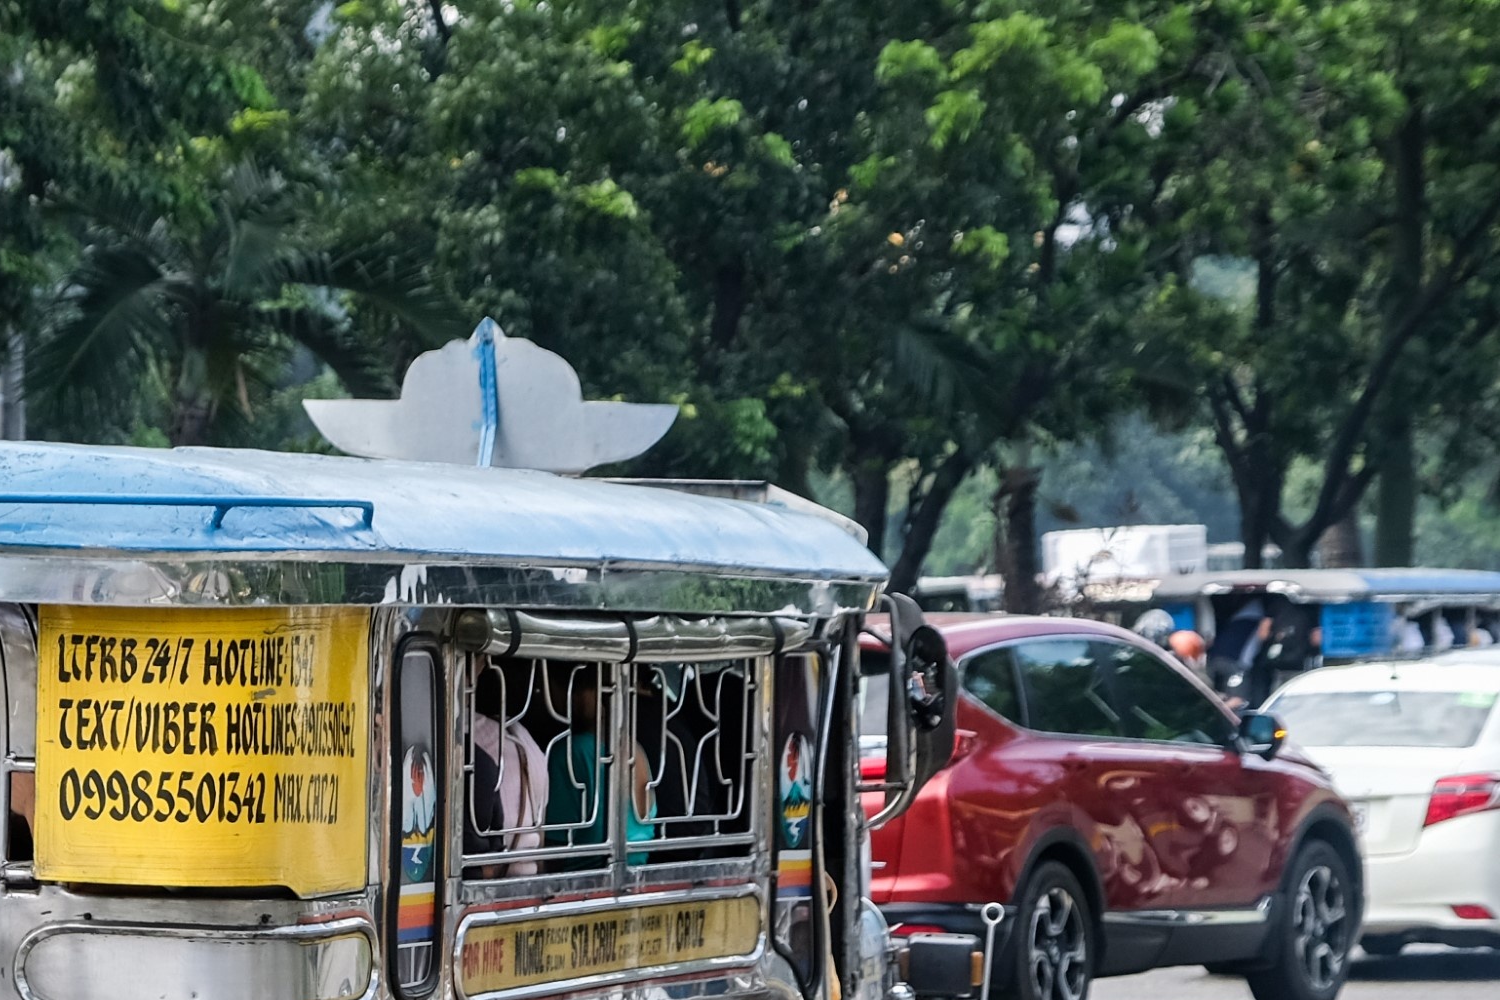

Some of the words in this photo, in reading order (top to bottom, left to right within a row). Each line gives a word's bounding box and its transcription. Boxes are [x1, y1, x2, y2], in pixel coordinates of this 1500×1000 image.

[58, 634, 138, 684] LTFRB
[142, 635, 194, 689] 24/7
[203, 637, 288, 688] HOTLINE:
[58, 695, 219, 757] TEXT/VIBER
[58, 767, 266, 824] 09985501342
